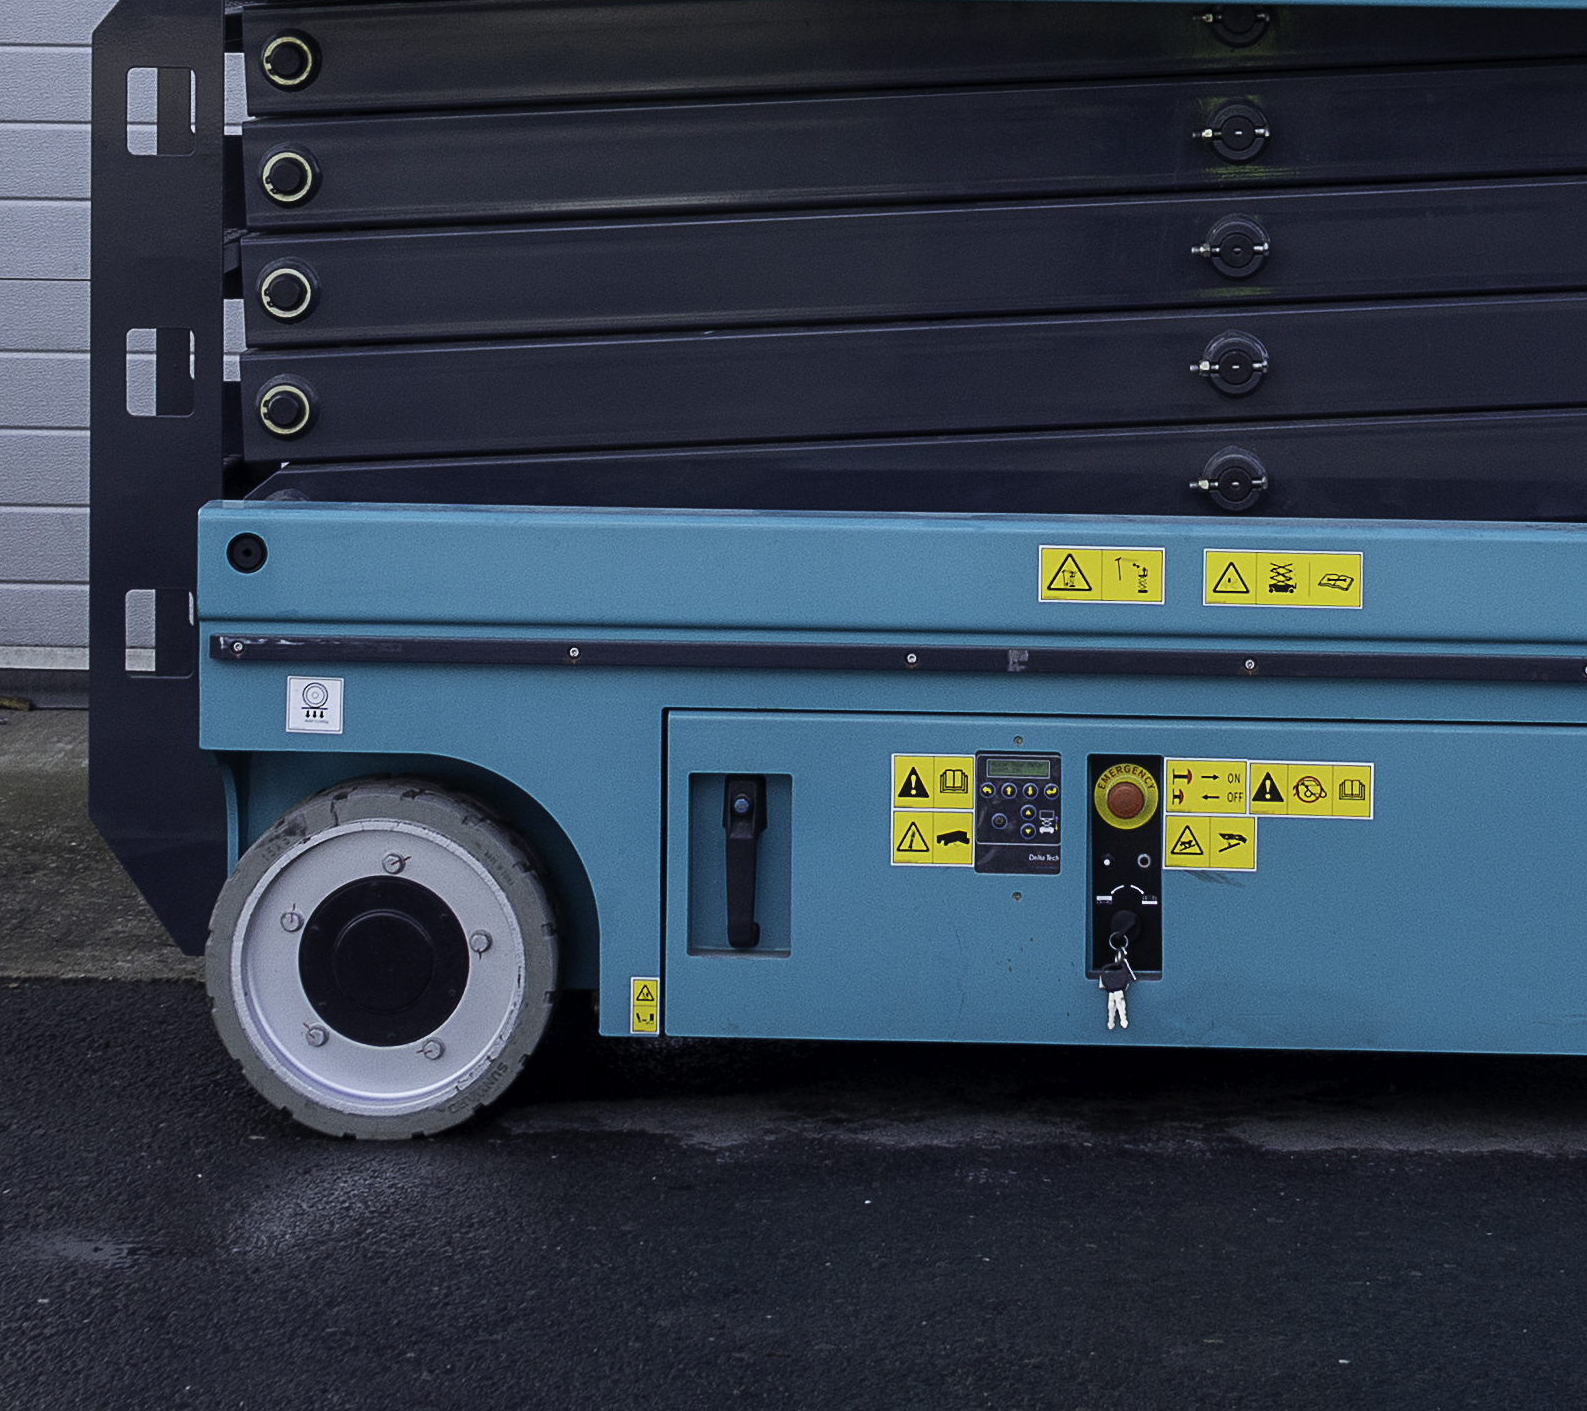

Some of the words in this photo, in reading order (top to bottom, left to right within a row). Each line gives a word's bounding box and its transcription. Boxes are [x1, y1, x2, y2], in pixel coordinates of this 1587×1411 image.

[1097, 764, 1156, 791] EMERGENCY
[1227, 773, 1241, 784] ON
[1226, 791, 1244, 803] OFF
